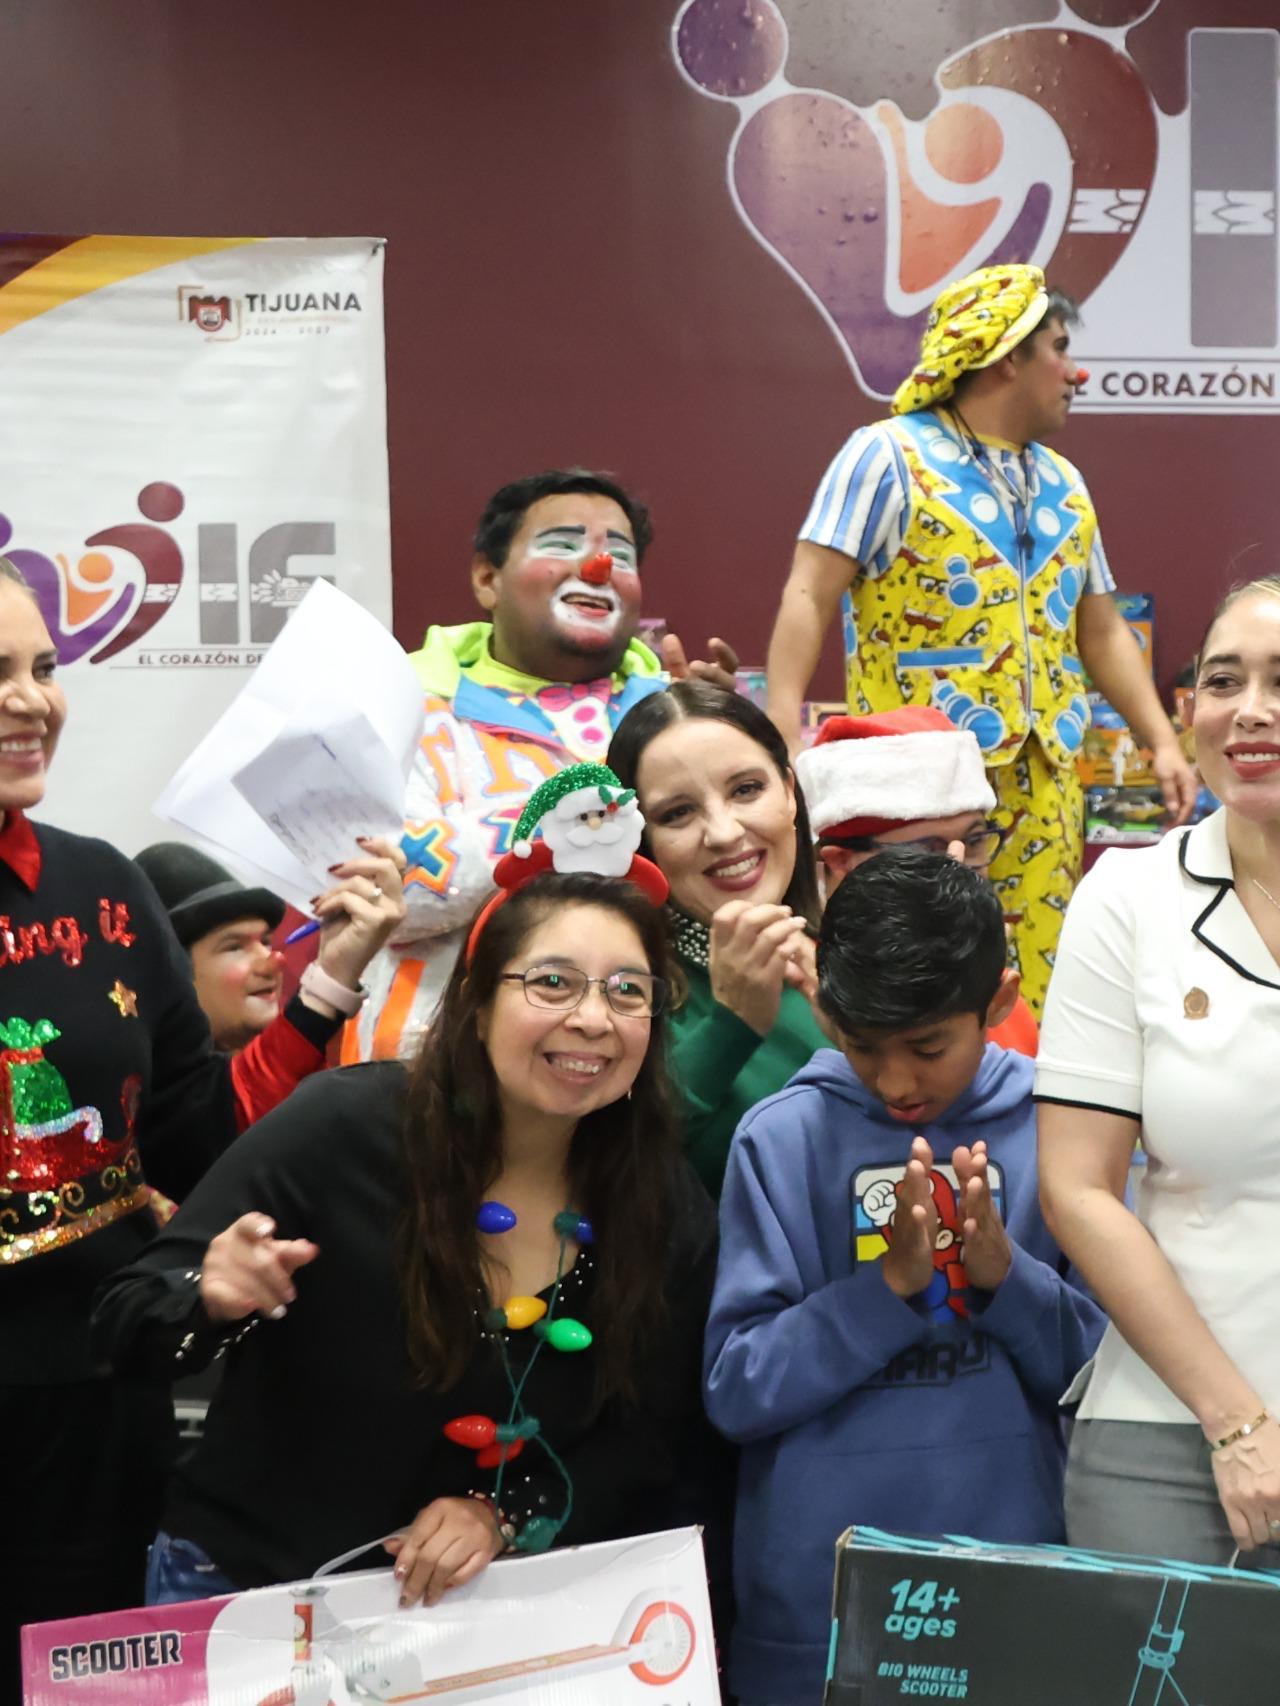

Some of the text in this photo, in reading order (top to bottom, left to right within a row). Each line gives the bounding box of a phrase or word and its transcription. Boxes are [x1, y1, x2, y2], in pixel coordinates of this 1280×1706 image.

[245, 292, 362, 312] TIJUANA
[1101, 365, 1276, 398] CORAZÓN
[138, 654, 155, 665] EL
[160, 650, 240, 665] CORAZÓN
[0, 897, 136, 967] ing it
[890, 1579, 960, 1614] 14+
[884, 1613, 958, 1640] ages
[51, 1631, 182, 1681] SCOOTER
[877, 1662, 969, 1682] BIG WHEELS
[899, 1679, 969, 1698] SCOOTER
